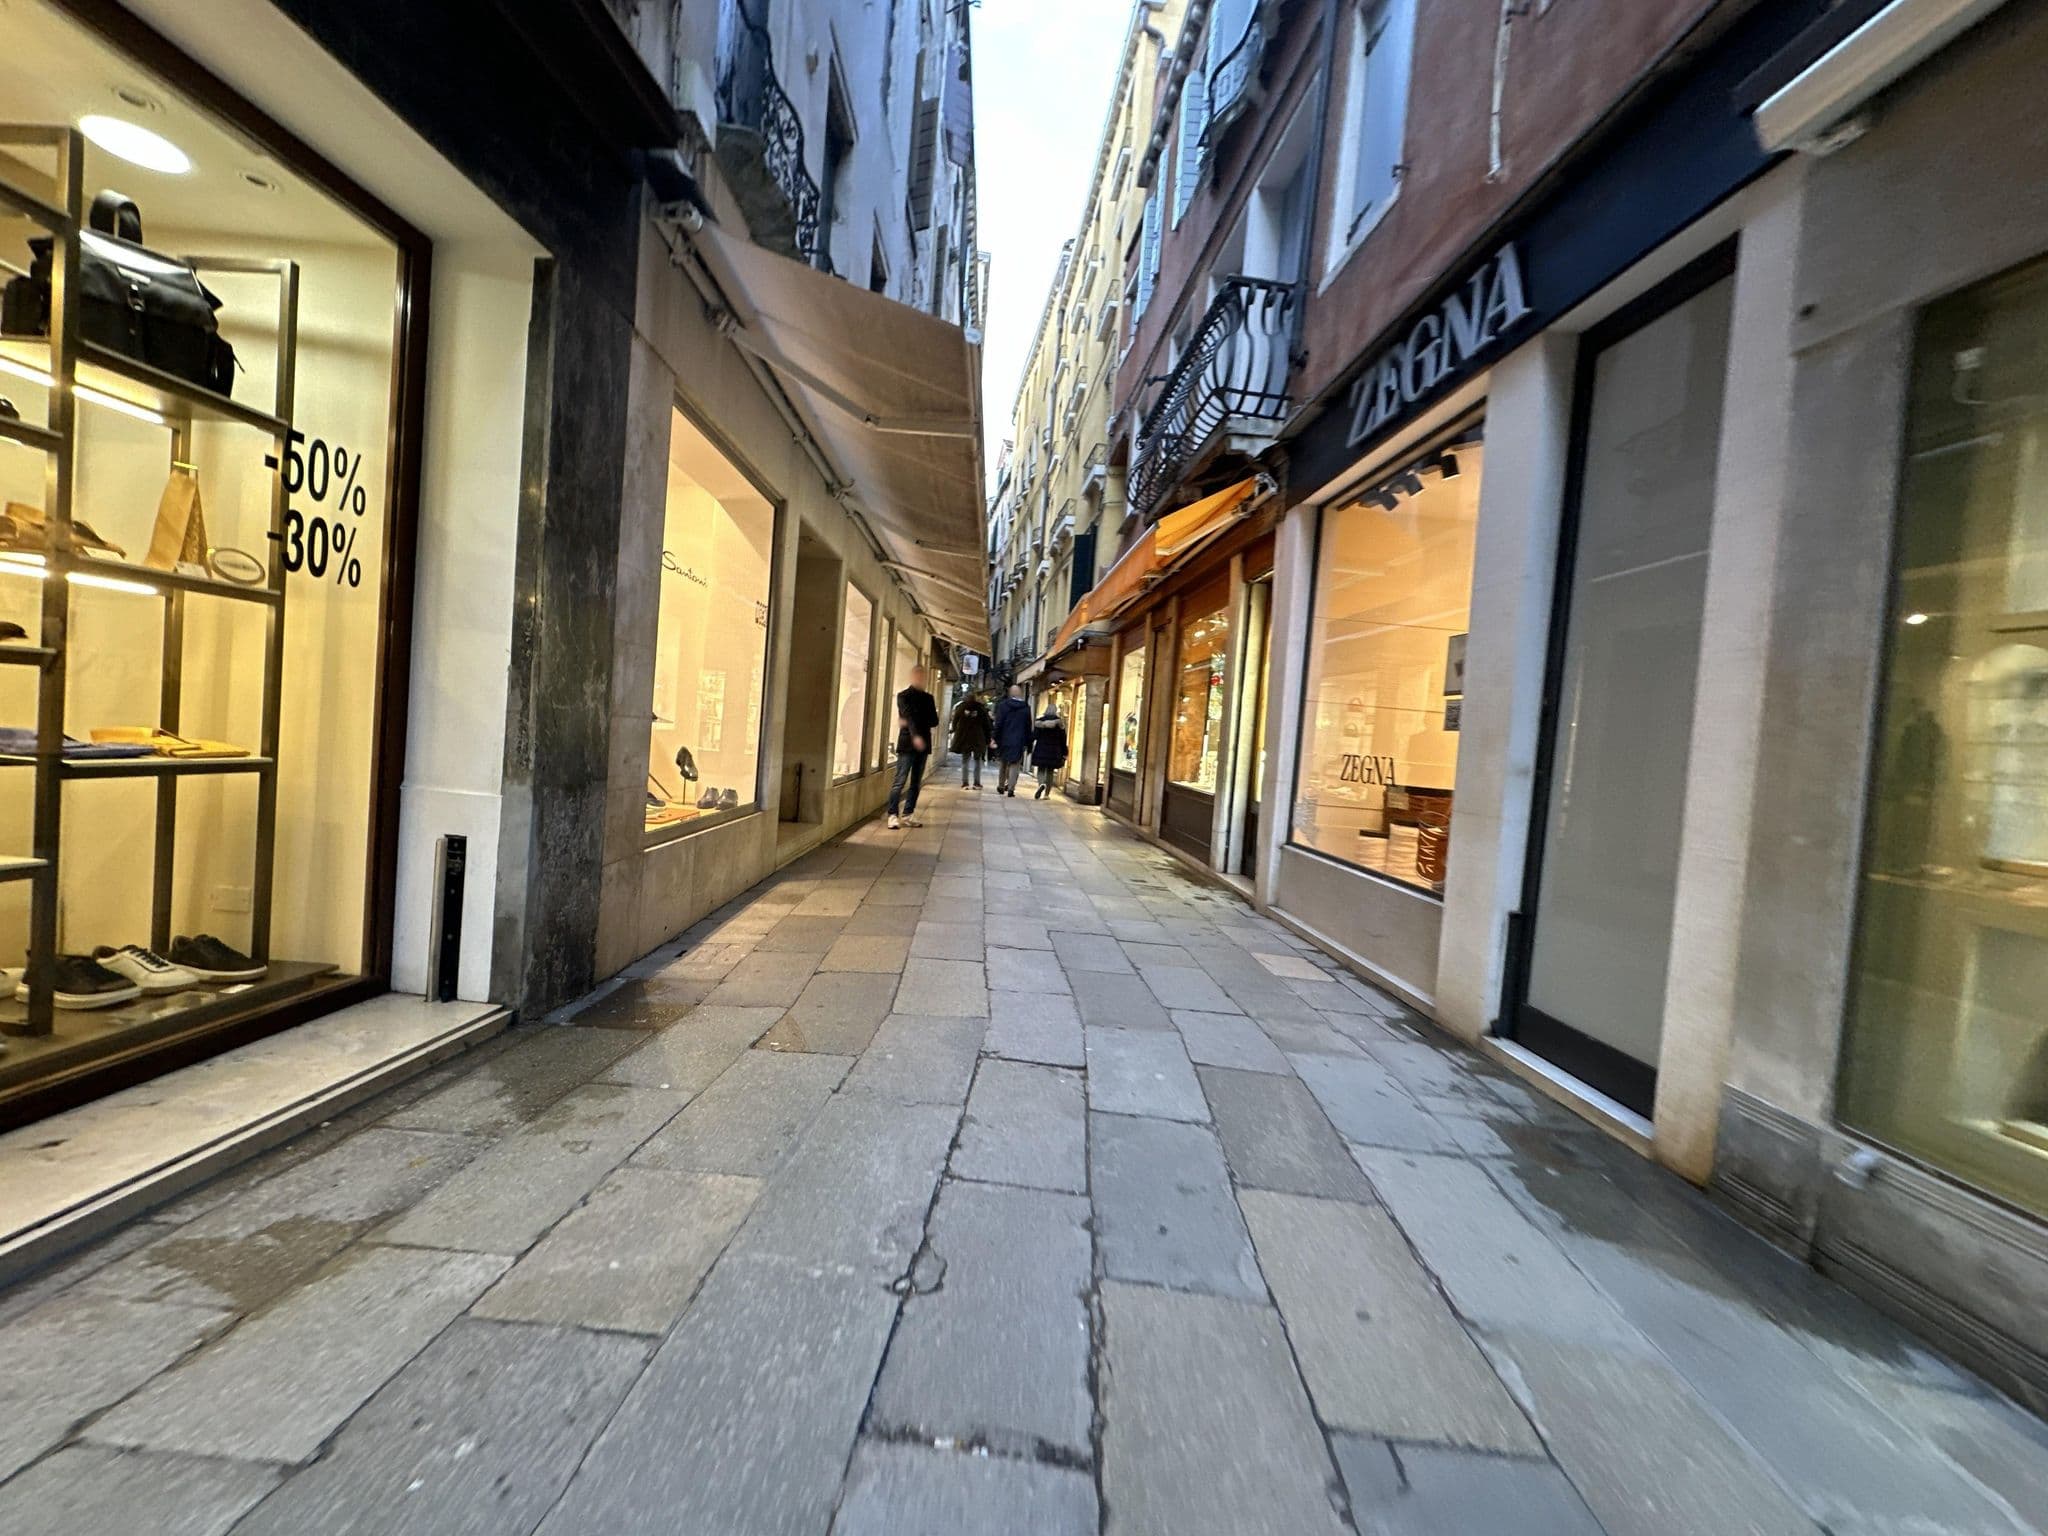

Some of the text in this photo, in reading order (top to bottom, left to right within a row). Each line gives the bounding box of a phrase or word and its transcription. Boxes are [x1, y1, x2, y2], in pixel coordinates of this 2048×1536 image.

[1346, 241, 1533, 448] ZEGNA
[265, 428, 366, 517] -50%
[267, 509, 361, 588] -30%
[1341, 754, 1395, 787] ZEGNA
